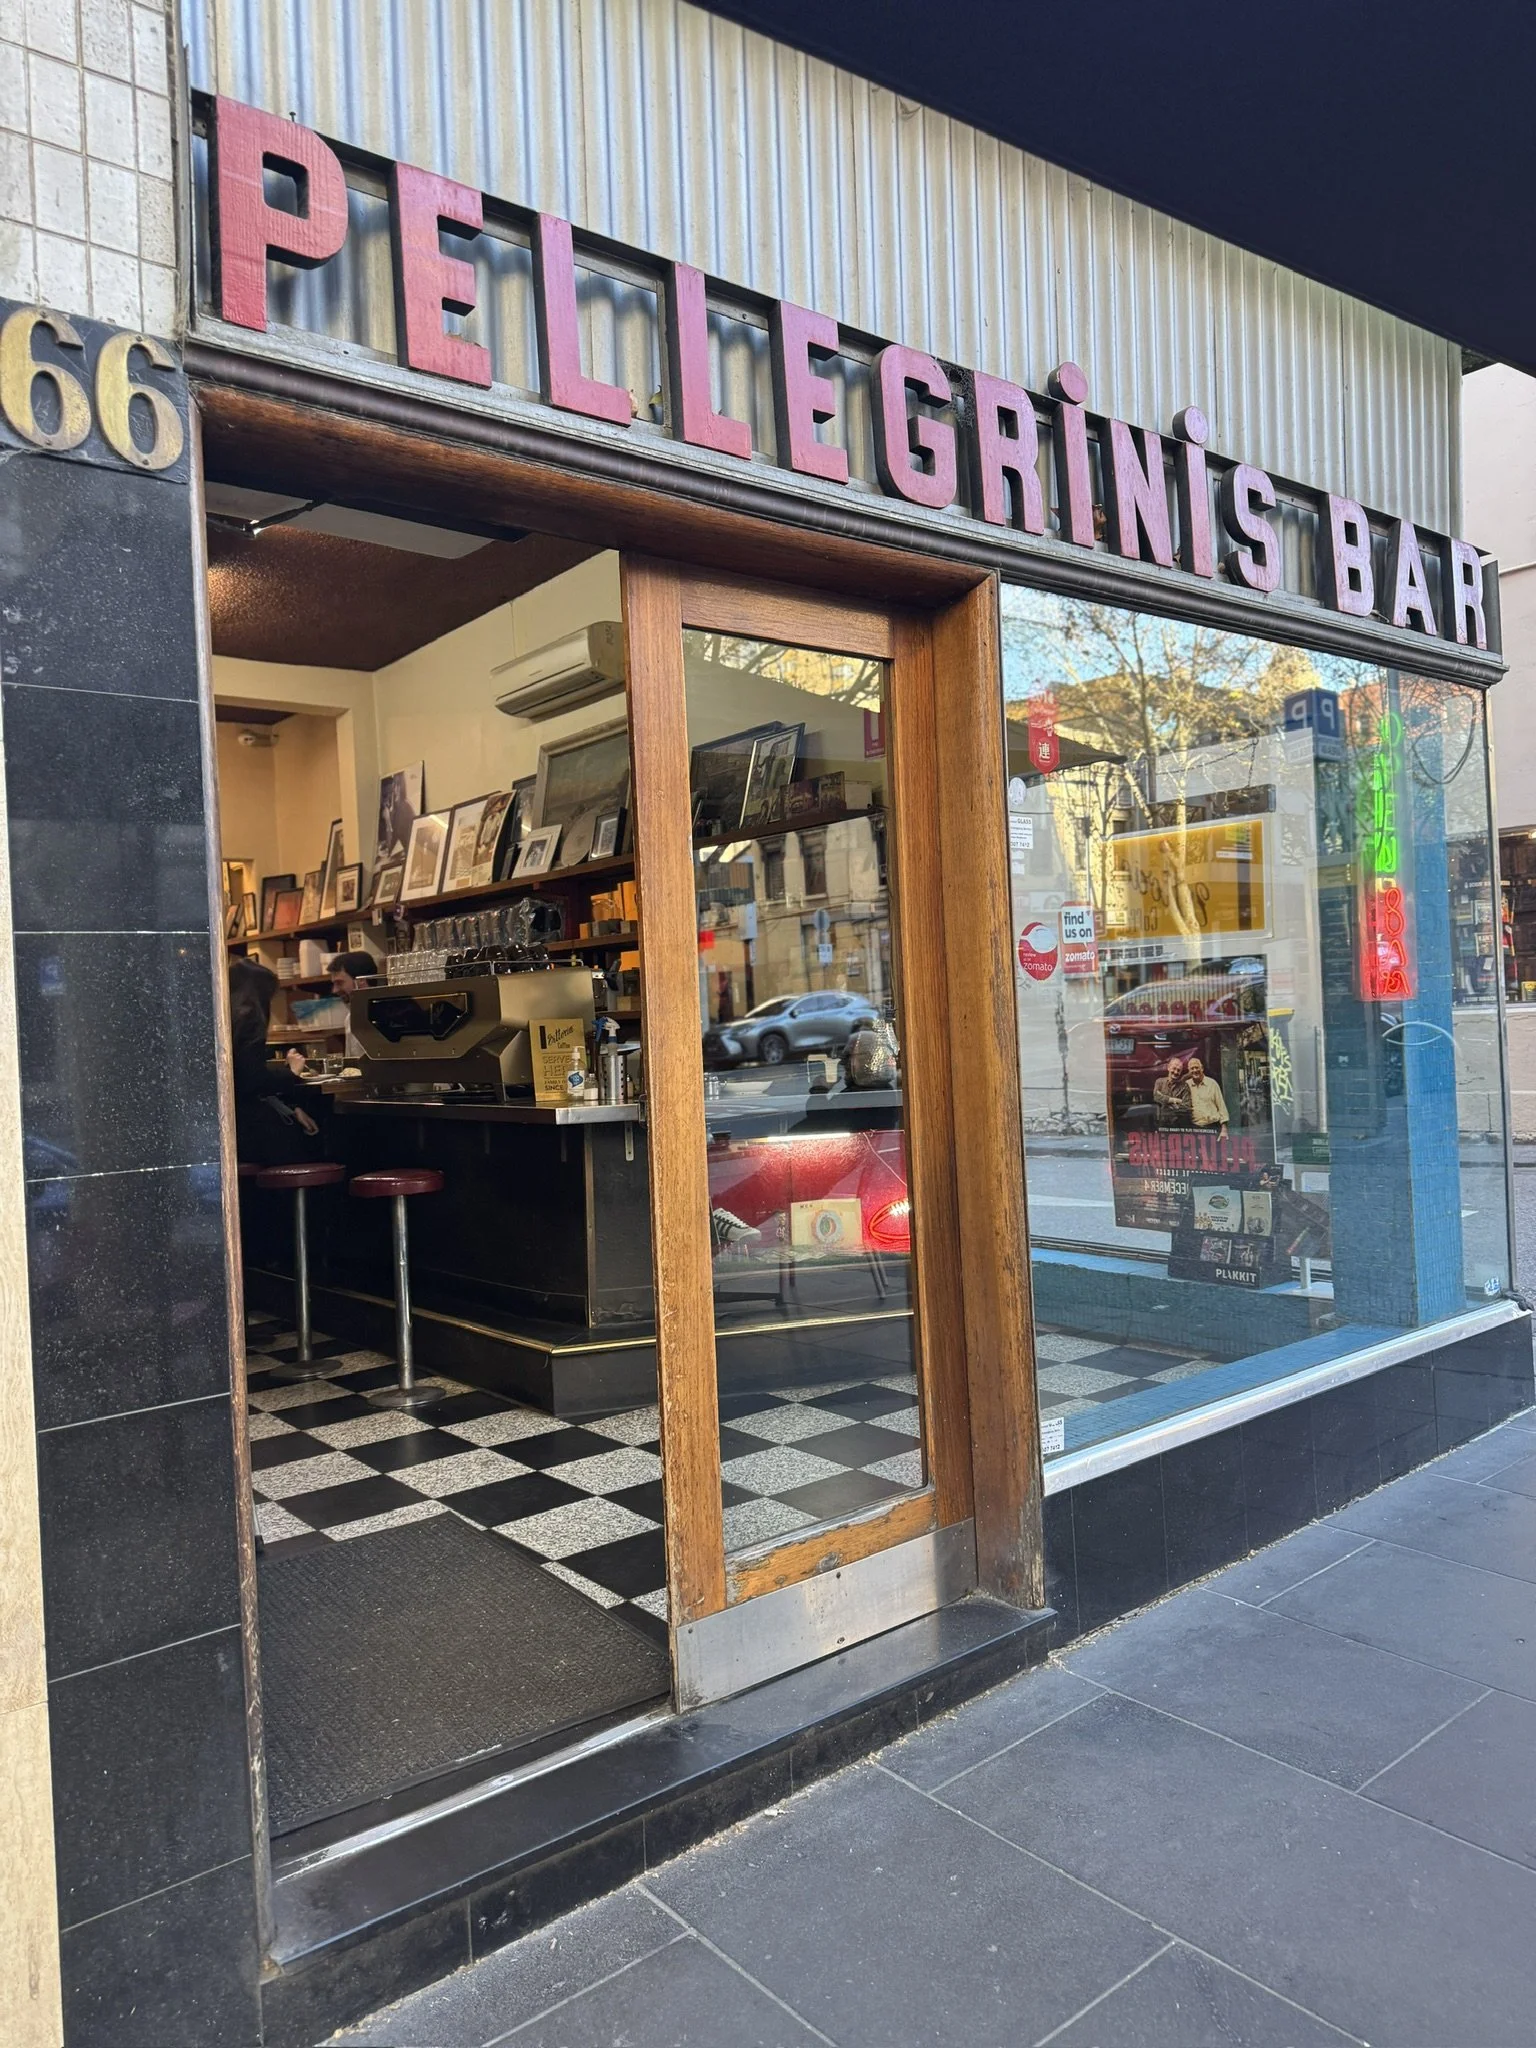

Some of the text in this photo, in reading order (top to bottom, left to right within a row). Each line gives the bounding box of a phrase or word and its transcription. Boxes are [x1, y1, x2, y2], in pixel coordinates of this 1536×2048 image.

[0, 306, 184, 471] 66
[1325, 492, 1488, 650] BAR
[1064, 911, 1084, 925] find
[1065, 927, 1092, 939] us on
[1383, 886, 1410, 994] BAR
[1065, 951, 1095, 962] zomato
[1023, 962, 1053, 971] zomato
[543, 1055, 571, 1065] SERVE
